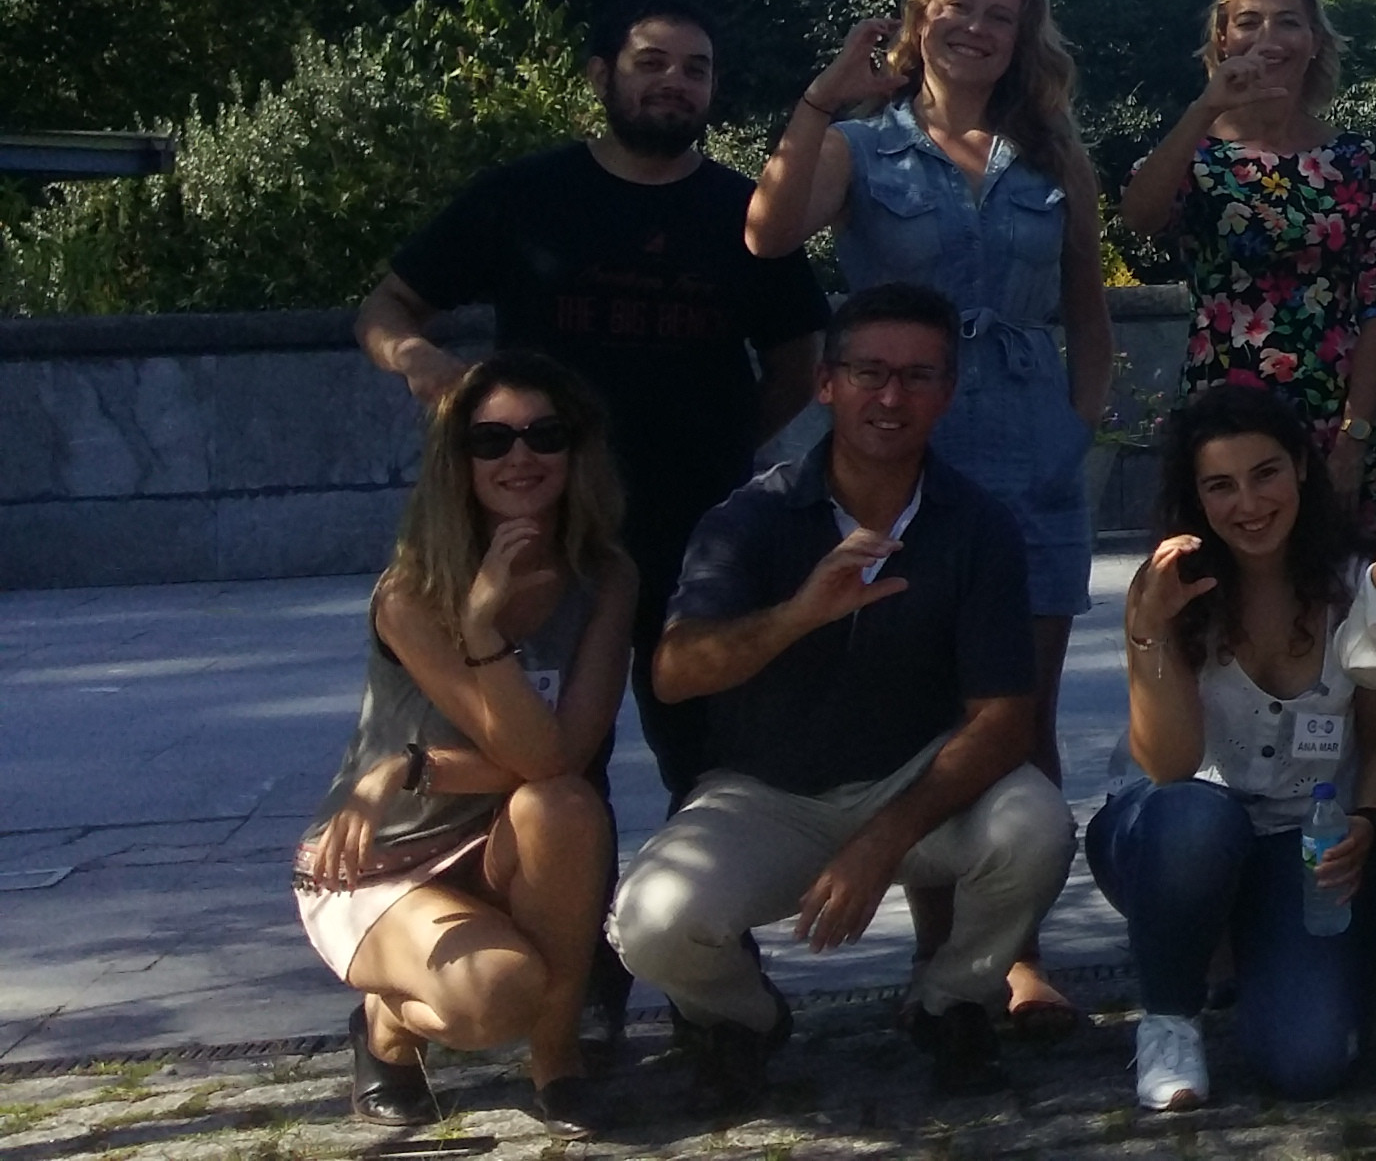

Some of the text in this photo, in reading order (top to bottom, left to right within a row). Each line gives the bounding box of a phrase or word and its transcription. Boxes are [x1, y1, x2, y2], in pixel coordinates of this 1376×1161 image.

[557, 295, 596, 333] THE
[611, 299, 647, 335] BIG
[1297, 741, 1339, 752] ANA MAR
